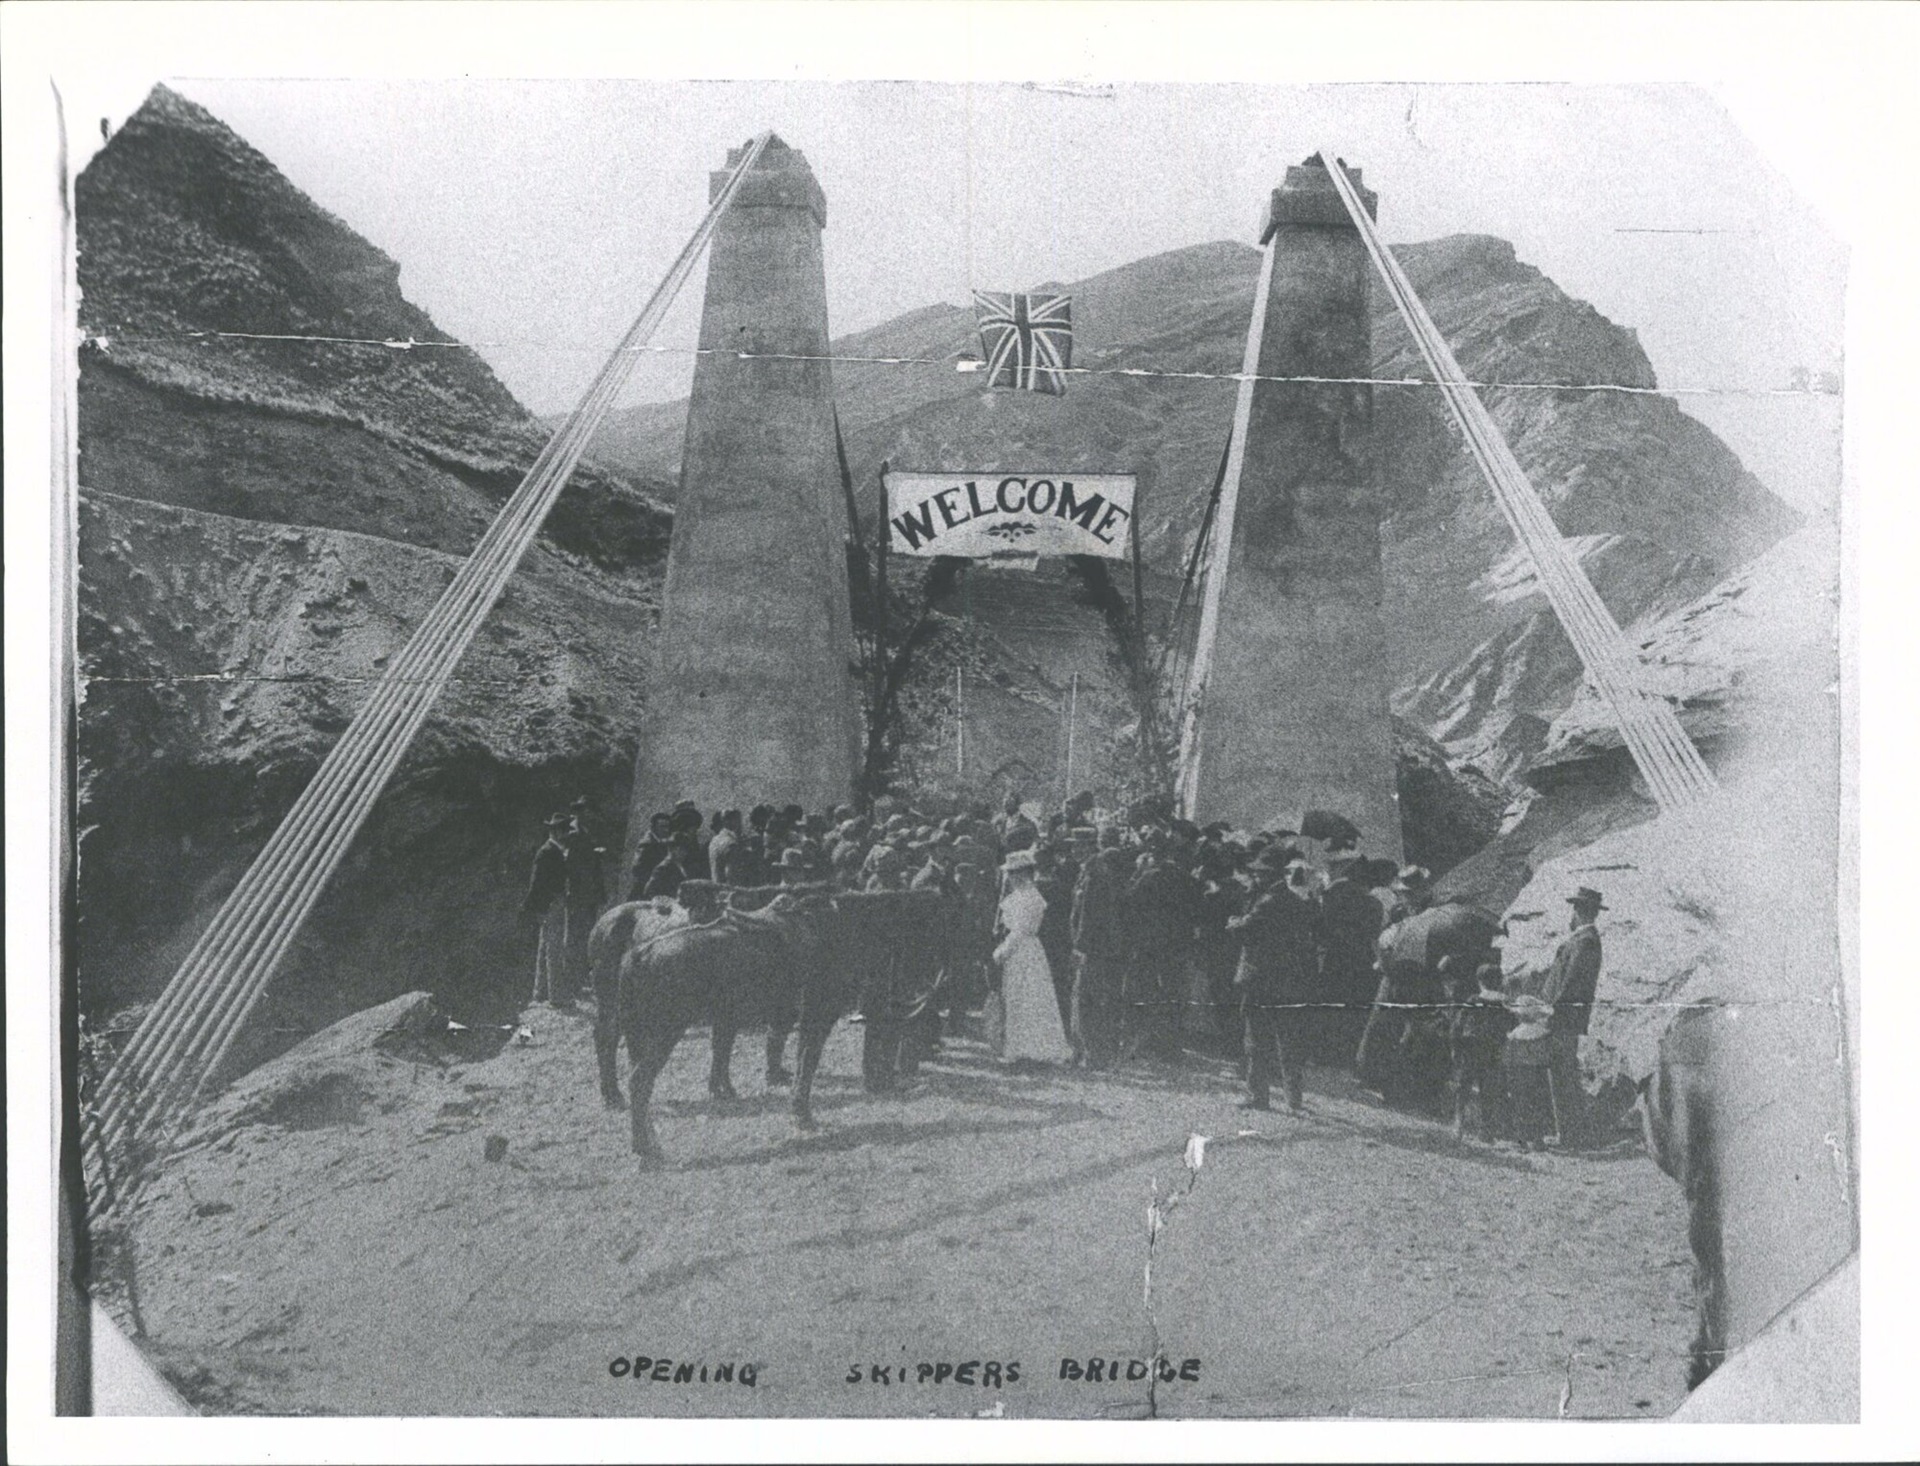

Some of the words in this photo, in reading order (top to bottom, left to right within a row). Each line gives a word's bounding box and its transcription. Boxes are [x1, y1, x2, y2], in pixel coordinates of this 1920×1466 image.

[891, 477, 1130, 551] WELCOME
[609, 1356, 757, 1387] OPENING
[1059, 1357, 1201, 1383] BRIDGE
